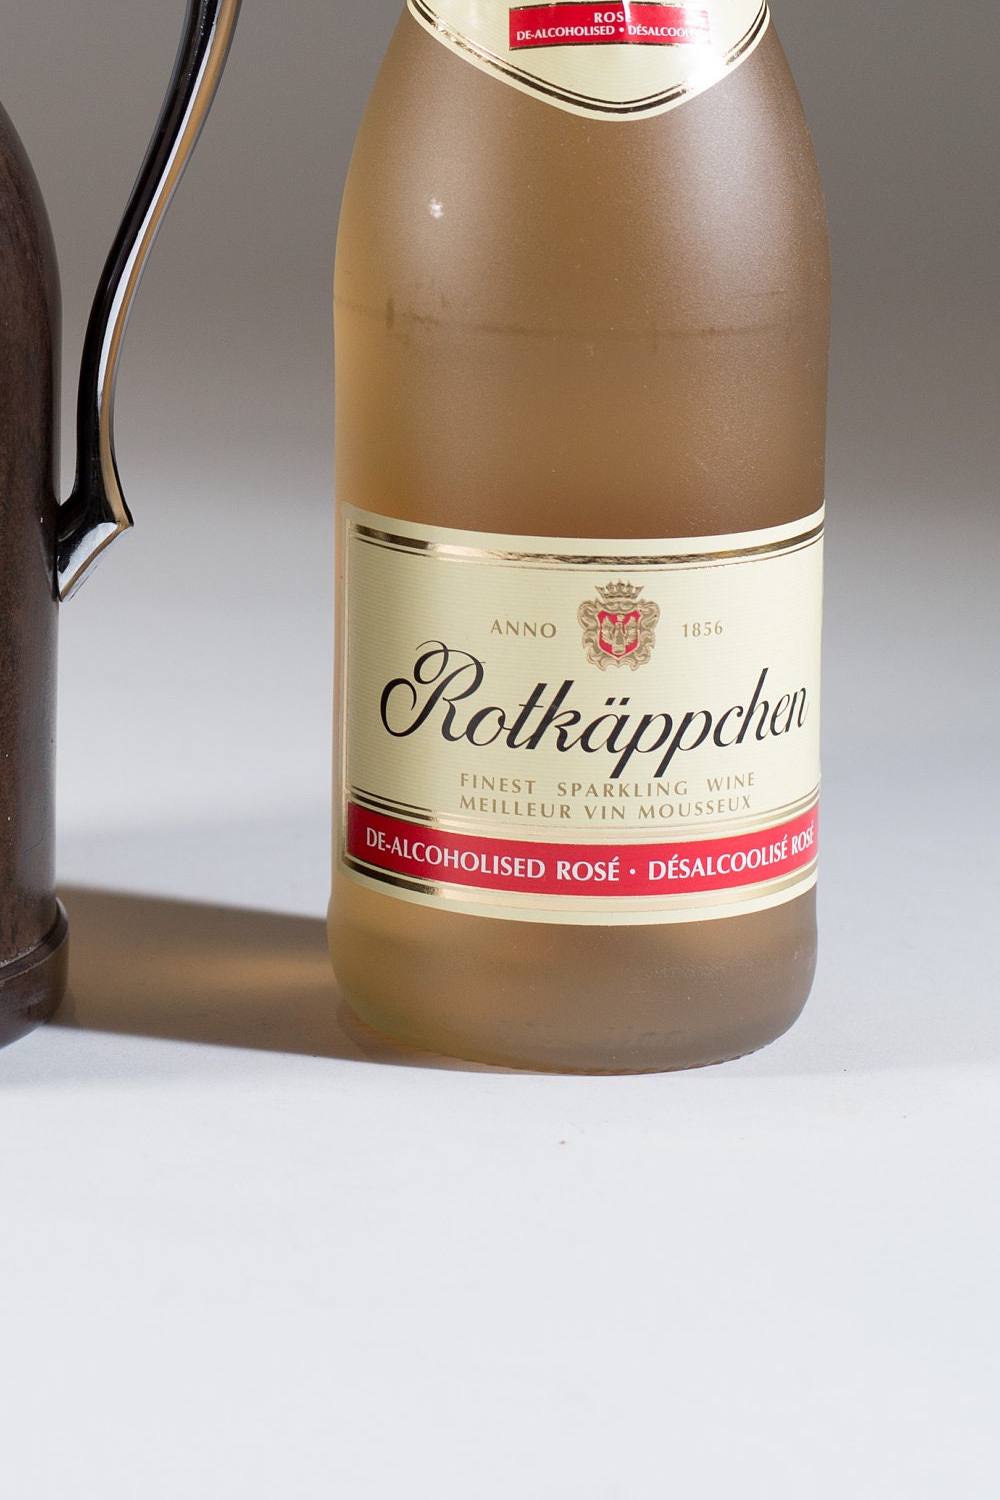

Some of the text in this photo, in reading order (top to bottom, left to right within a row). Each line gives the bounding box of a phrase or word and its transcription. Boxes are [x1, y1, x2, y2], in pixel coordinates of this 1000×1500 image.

[516, 25, 615, 41] DE-ALCOHOLISED
[490, 619, 723, 639] ANNO 1856
[380, 639, 809, 780] Rotkäppchen
[459, 771, 755, 798] FINEST SPARKLING WINE
[459, 794, 751, 820] MEILLEUR VIN MOUSSEUX
[365, 820, 815, 882] DE-ALCOHOLISED ROSÉ DÉSALCOOLISÉ ROSÉ
